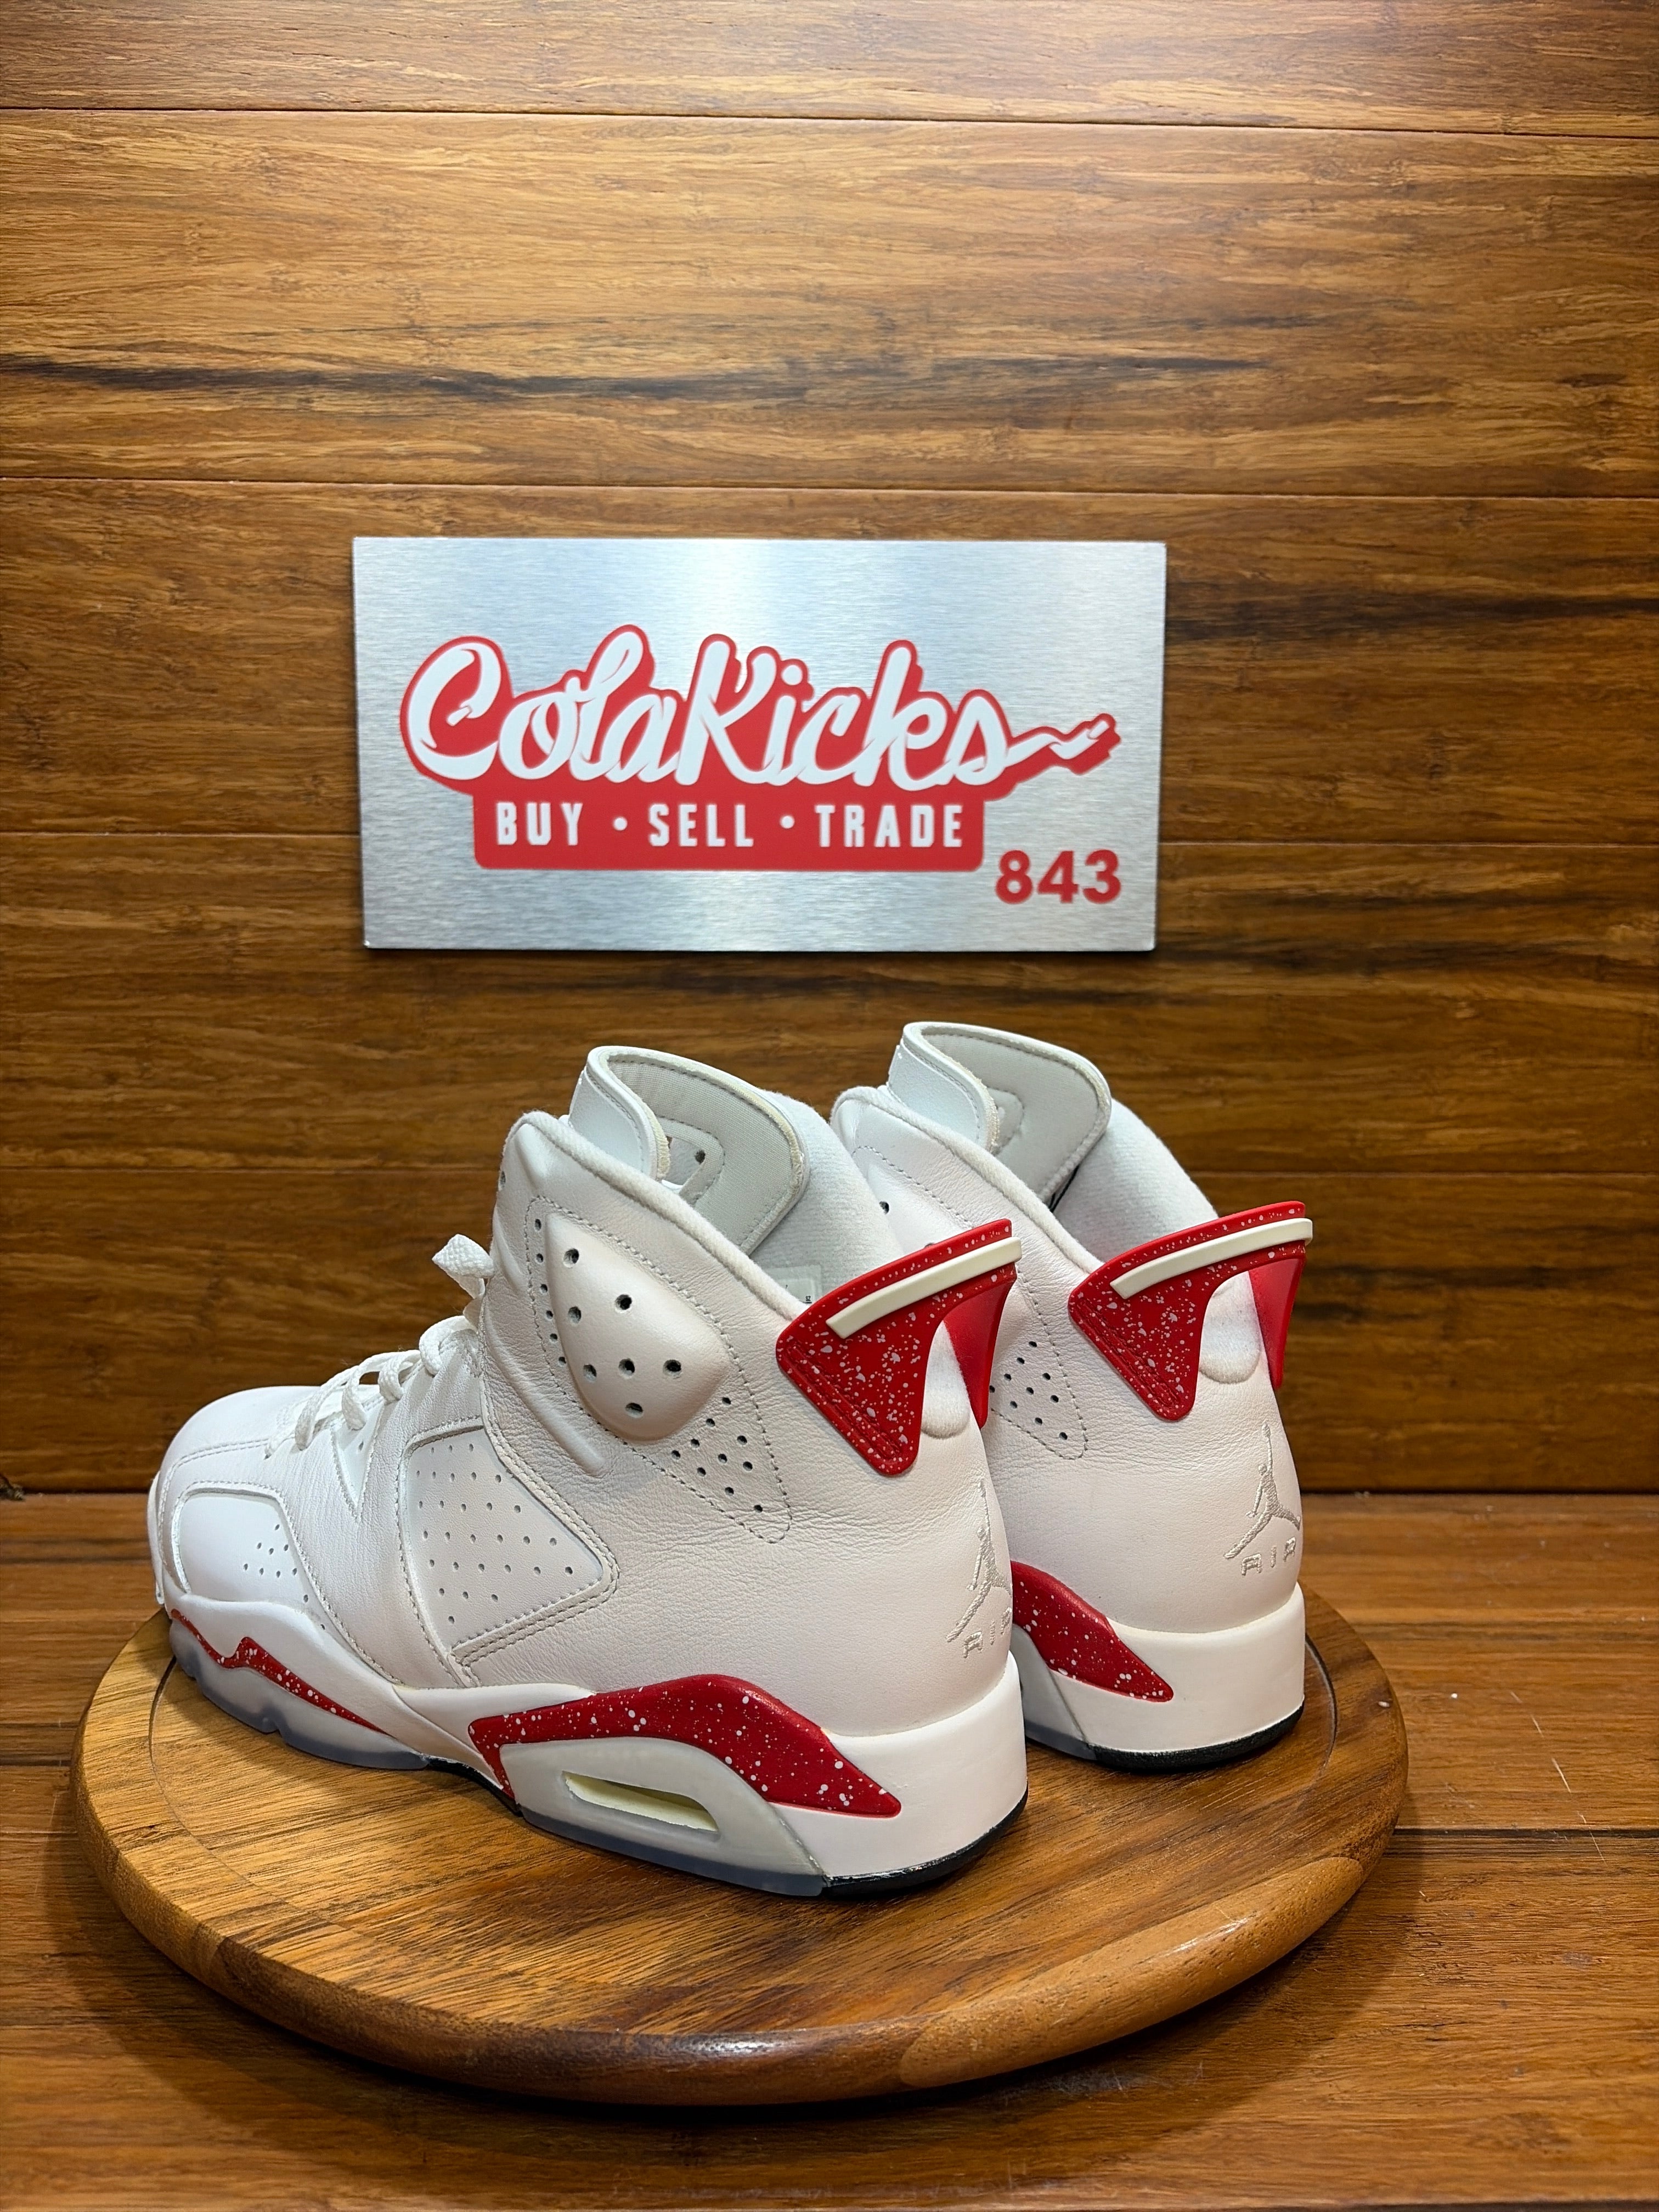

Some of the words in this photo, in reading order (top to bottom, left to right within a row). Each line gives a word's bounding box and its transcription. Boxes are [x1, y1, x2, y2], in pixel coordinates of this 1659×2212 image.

[403, 627, 1114, 792] ColaKicks
[496, 802, 583, 845] BUY
[648, 803, 754, 847] SELL
[815, 804, 962, 848] TRADE
[995, 849, 1121, 904] 843
[1241, 1537, 1296, 1576] AIR
